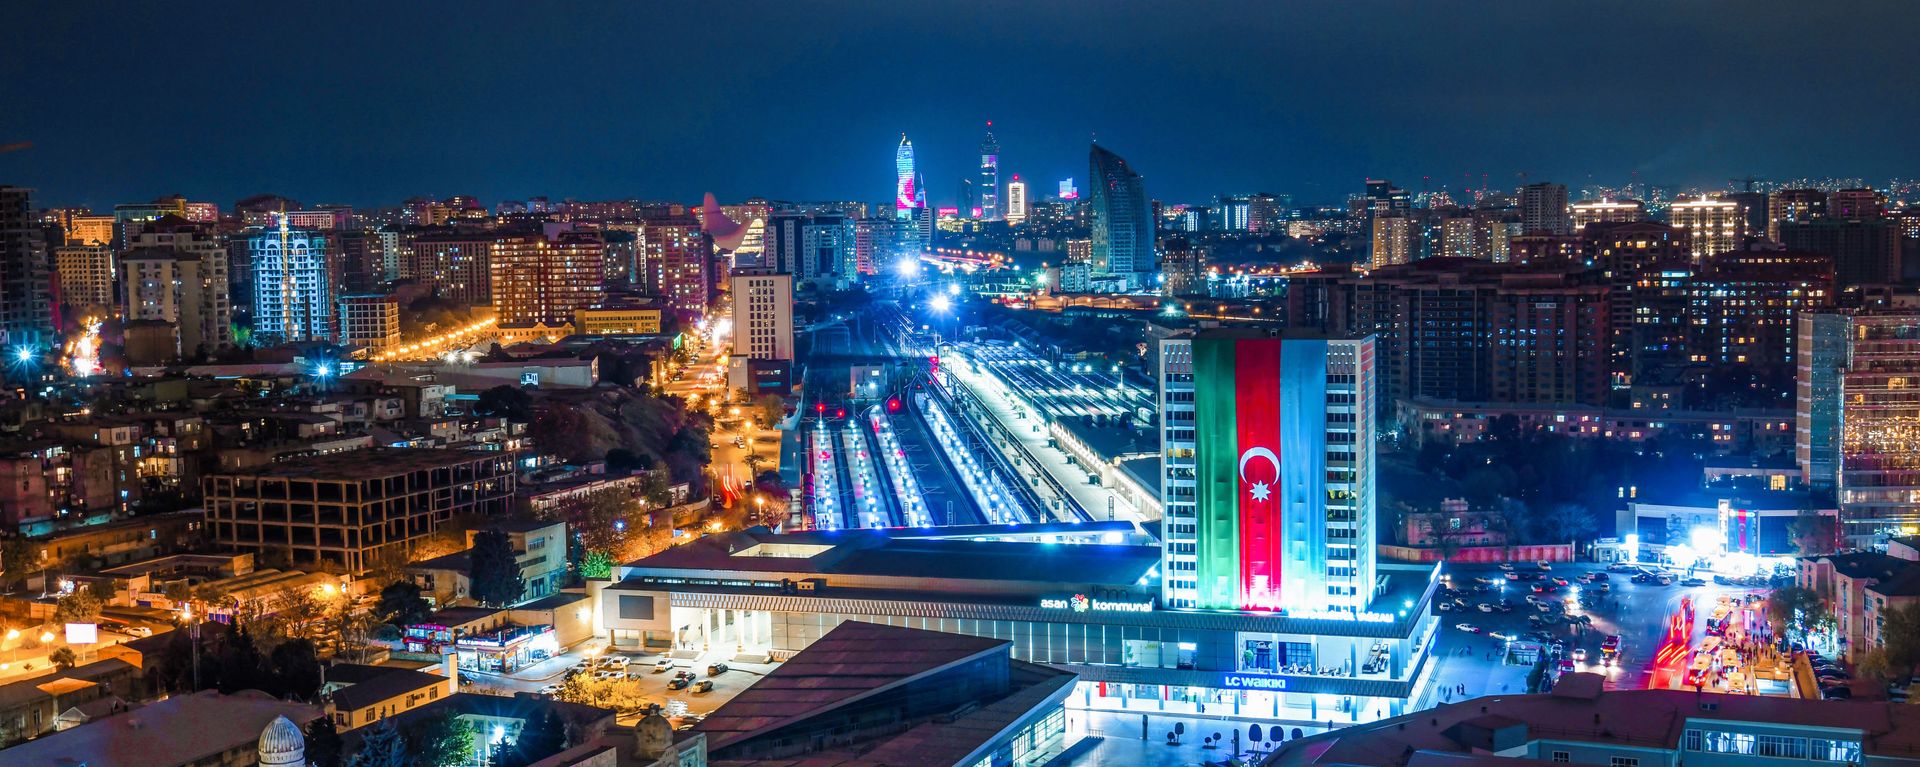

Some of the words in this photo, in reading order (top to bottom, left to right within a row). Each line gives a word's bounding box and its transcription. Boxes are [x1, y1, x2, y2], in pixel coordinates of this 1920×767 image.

[1040, 598, 1068, 609] asan
[1092, 599, 1153, 612] kommunal
[1225, 676, 1240, 687] LC
